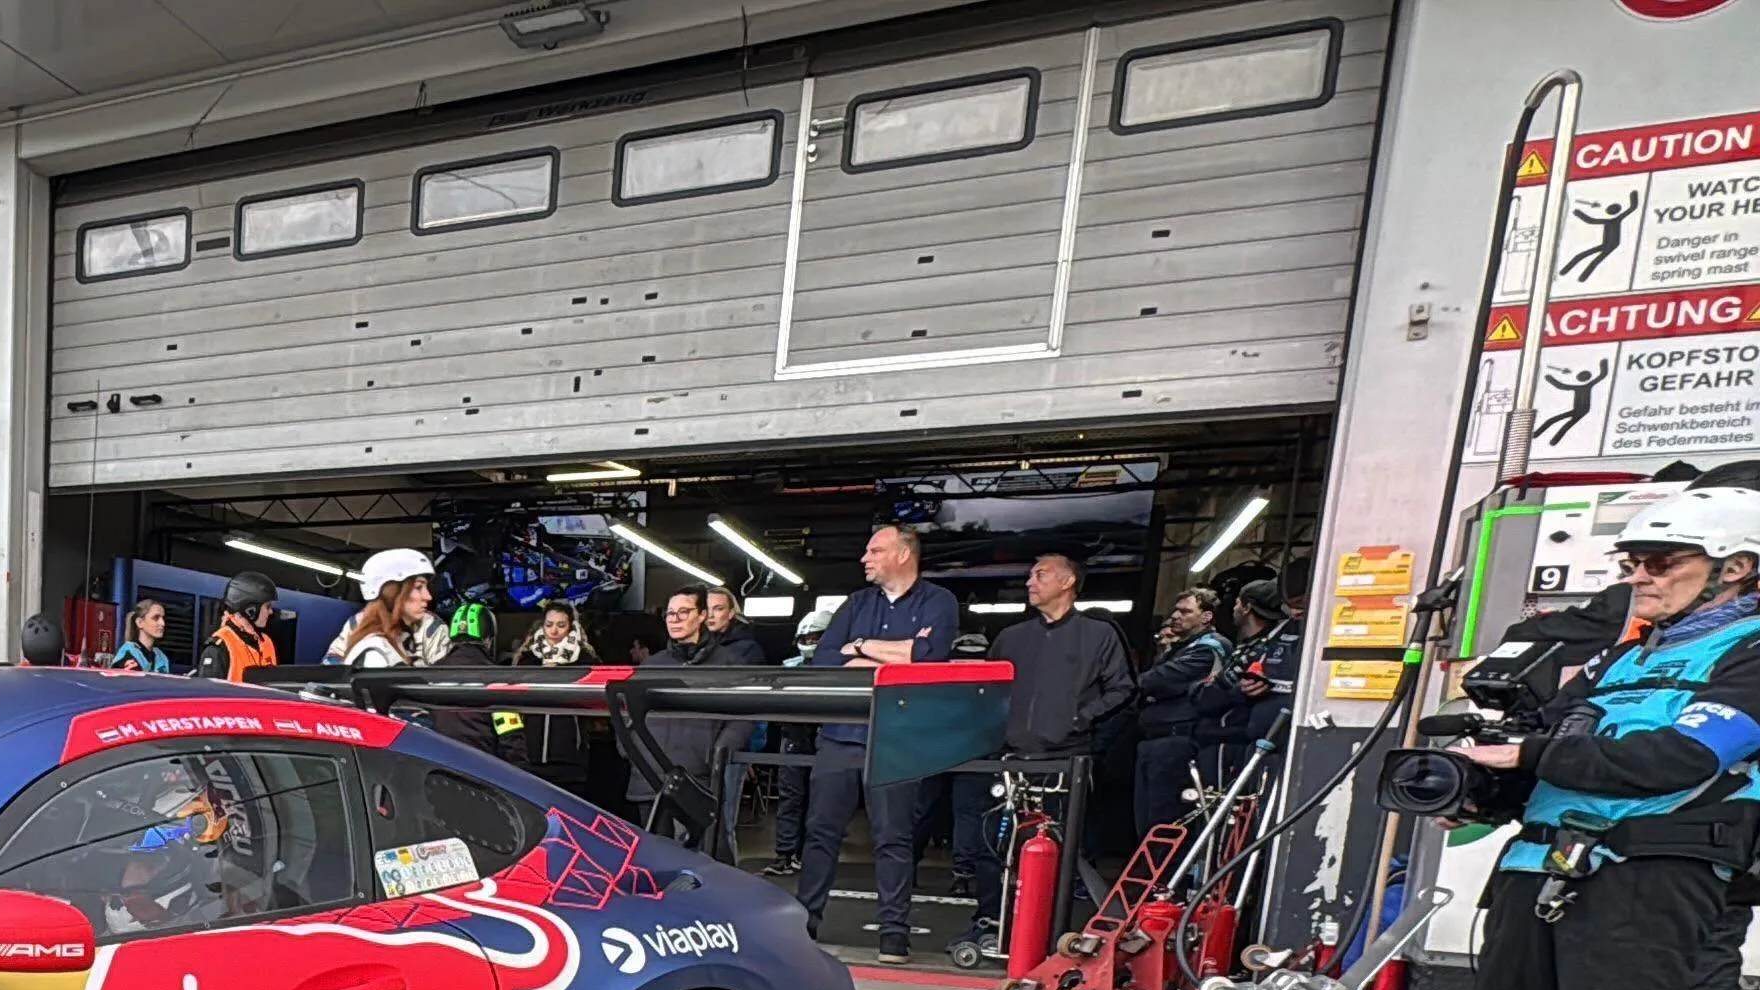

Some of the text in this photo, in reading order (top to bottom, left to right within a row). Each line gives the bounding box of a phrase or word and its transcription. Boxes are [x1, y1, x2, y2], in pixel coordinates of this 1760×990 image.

[1576, 125, 1753, 169] CAUTION
[1654, 204, 1724, 224] YOUR
[1657, 231, 1739, 253] Danger in
[1653, 246, 1759, 267] swivel range
[1651, 262, 1750, 284] spring mast
[1544, 296, 1743, 337] ACHTUNG
[1640, 369, 1755, 393] GEFAHR
[1618, 404, 1675, 419] Gefahr
[1679, 400, 1741, 415] besteht
[1616, 416, 1751, 435] Schwenkbereich
[1612, 430, 1754, 450] des Federmastes
[1540, 566, 1561, 590] 9
[119, 717, 262, 738] M. VERSTAPPEN
[294, 720, 362, 740] L. AUER
[642, 919, 739, 957] viaplay
